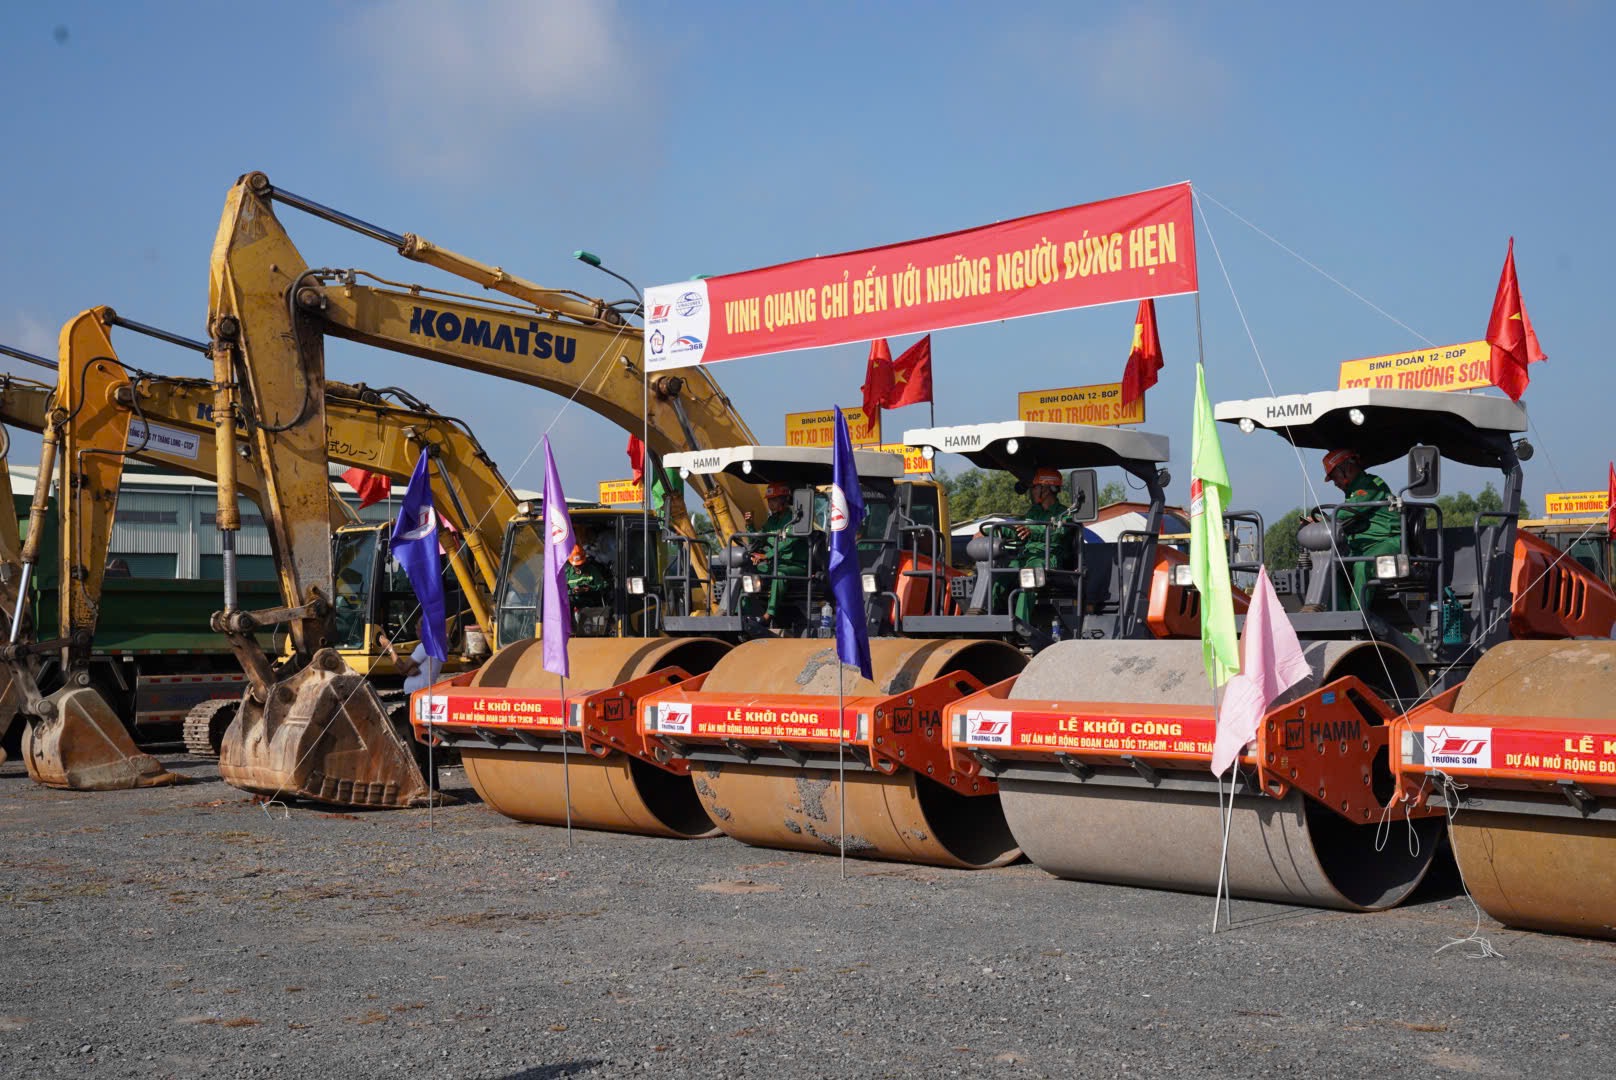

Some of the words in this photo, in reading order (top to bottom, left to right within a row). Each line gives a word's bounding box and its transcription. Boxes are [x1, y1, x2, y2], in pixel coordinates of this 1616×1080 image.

[725, 297, 760, 334] VINH
[764, 287, 817, 332] QUANG
[821, 269, 849, 320] CHỈ
[853, 264, 888, 314] ĐẾN
[892, 262, 921, 309] VỚI
[926, 254, 991, 303] NHỮNG
[997, 237, 1059, 291] NGƯỜI
[1064, 230, 1123, 280] ĐÚNG
[1129, 222, 1177, 275] HẸN
[410, 306, 576, 363] KOMATSU
[1369, 360, 1392, 371] BINH
[1396, 354, 1425, 367] ĐOÀN
[1429, 353, 1439, 362] 12
[1397, 365, 1454, 389] TRƯỜNG
[1040, 396, 1059, 404] BINH
[1061, 392, 1085, 402] ĐOÀN
[1088, 392, 1097, 400] 12
[1065, 401, 1110, 423] TRƯỜNG
[1266, 402, 1312, 419] HAMM
[790, 429, 804, 445] TCT
[806, 428, 818, 445] XD
[944, 434, 981, 447] HAMM
[693, 456, 721, 467] HAMM
[913, 456, 928, 469] SƠN
[1550, 502, 1562, 512] TCT
[488, 700, 511, 712] KHỞI
[513, 701, 542, 713] CÔNG
[727, 708, 742, 721] LỄ
[745, 709, 777, 723] KHỞI
[781, 711, 819, 725] CÔNG
[760, 727, 773, 736] CAO
[812, 728, 828, 738] LONG
[1058, 716, 1078, 732] LỄ
[1084, 718, 1126, 734] KHỞI
[1131, 721, 1182, 736] CÔNG
[1309, 719, 1361, 743] HAMM
[1021, 733, 1031, 745] DỰ
[1032, 733, 1043, 744] ÁN
[1044, 733, 1057, 745] MỞ
[1058, 734, 1079, 748] RỘNG
[1080, 737, 1102, 750] ĐOẠN
[1103, 739, 1119, 748] CAO
[1121, 736, 1136, 749] TỐC
[1138, 740, 1167, 750] TP.HCM
[1173, 741, 1195, 752] LONG
[1564, 735, 1594, 754] LỄ
[1432, 754, 1460, 764] TRƯỜNG
[1461, 755, 1478, 765] SƠN
[1506, 753, 1522, 768] DỰ
[1523, 753, 1540, 767] ÁN
[1543, 754, 1561, 769] MỞ
[1564, 757, 1596, 773] RỘNG
